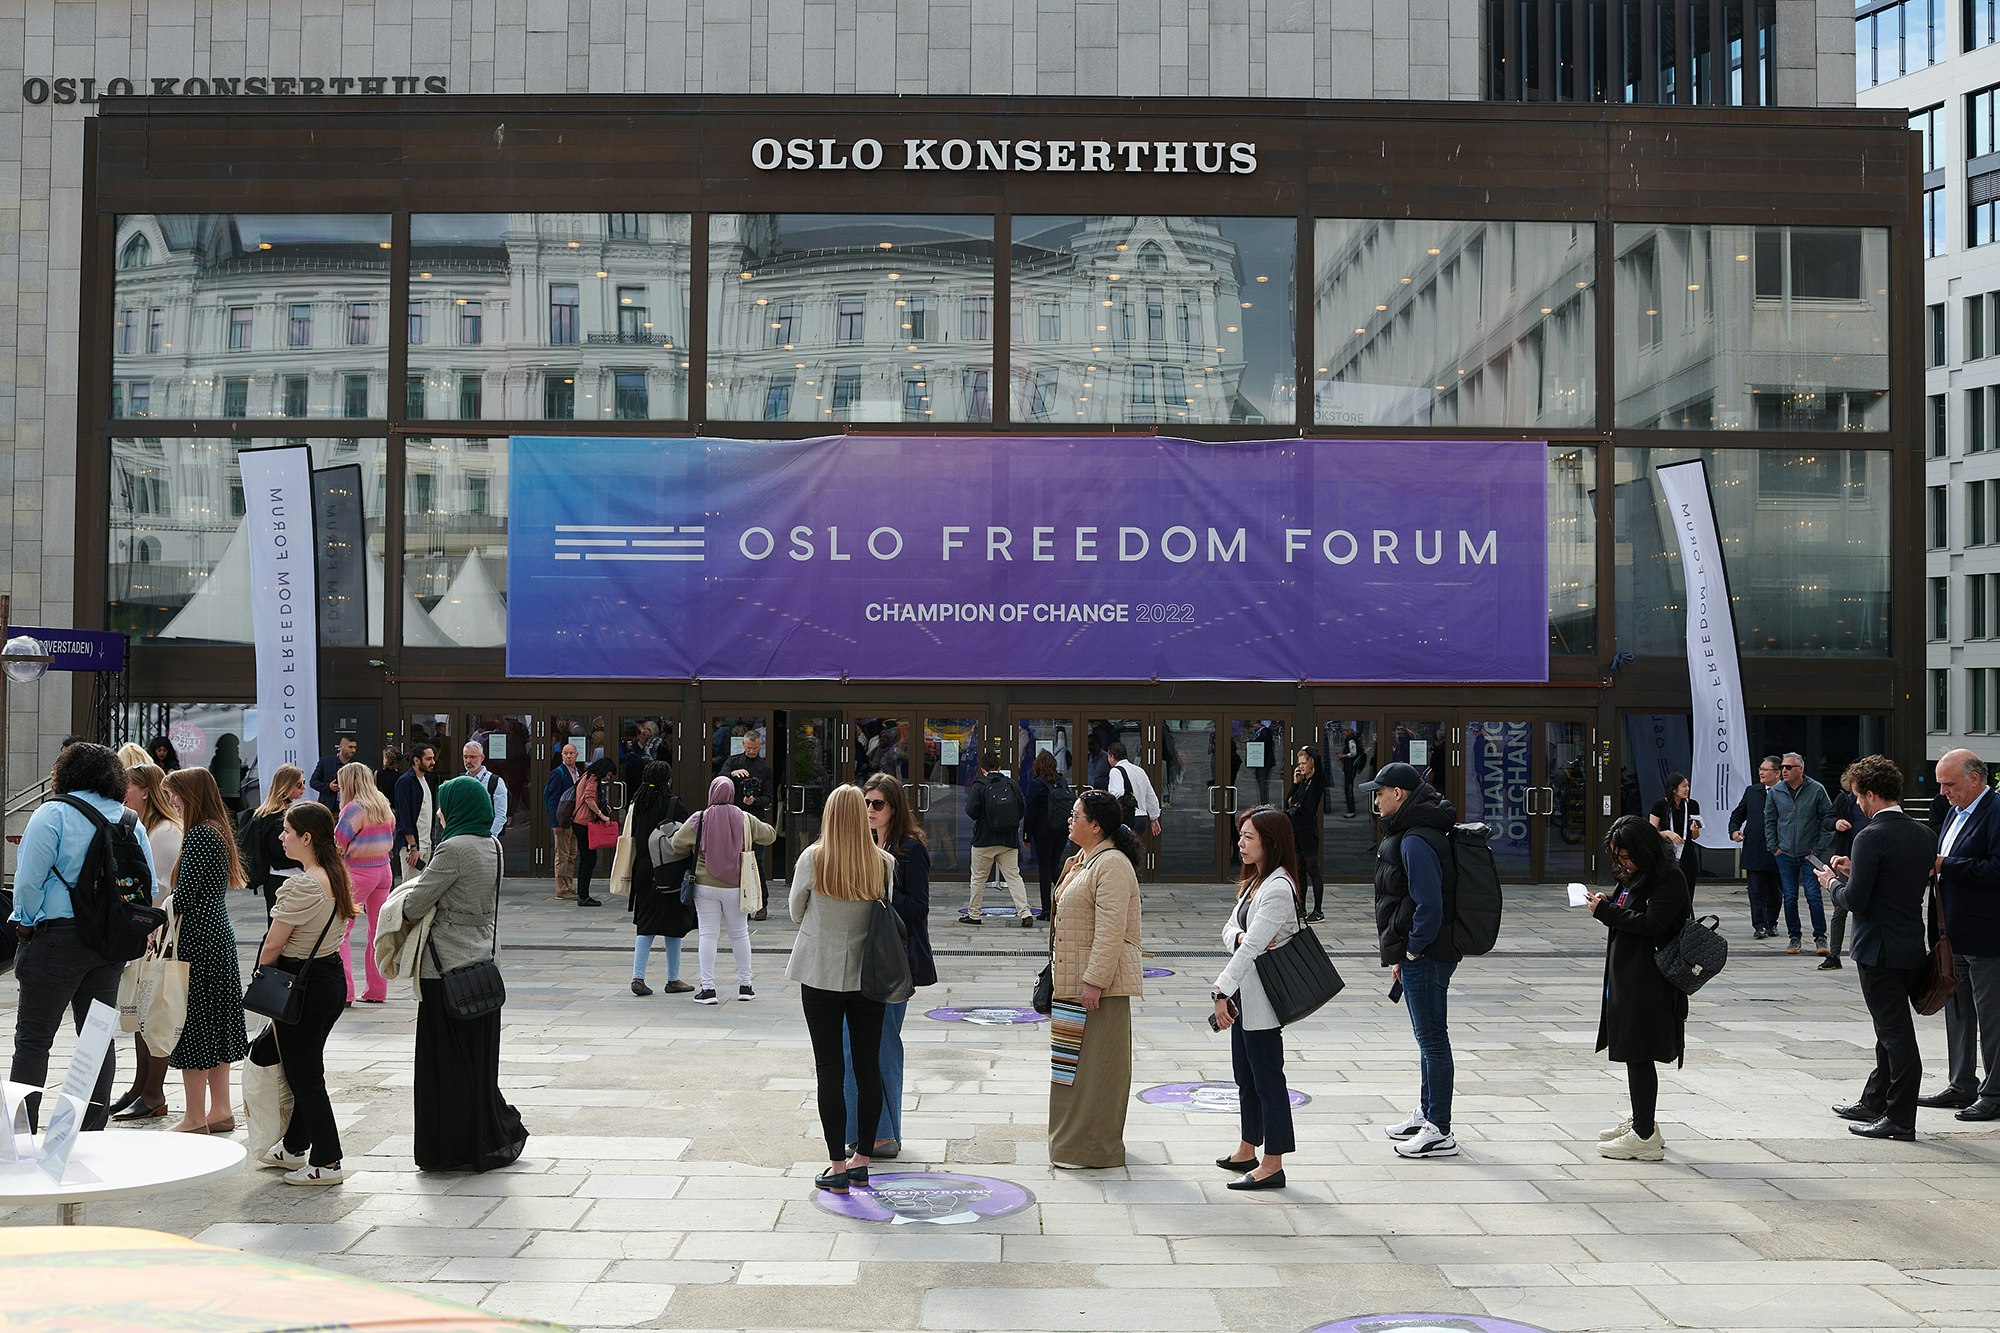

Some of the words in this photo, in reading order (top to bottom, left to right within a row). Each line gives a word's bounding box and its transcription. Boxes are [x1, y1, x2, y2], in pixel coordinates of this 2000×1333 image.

[22, 77, 134, 105] OSLO
[150, 76, 447, 96] KONSERTHUS
[752, 138, 883, 170] OSLO
[903, 139, 1257, 174] KONSERTHUS
[739, 526, 904, 561] OSLO
[943, 526, 1246, 563] FREEDOM
[1285, 529, 1497, 565] FORUM
[866, 603, 994, 622] CHAMPION
[999, 603, 1030, 622] OF
[1032, 603, 1129, 623] CHANGE
[1136, 603, 1195, 623] 2022
[1507, 810, 1528, 840] OF
